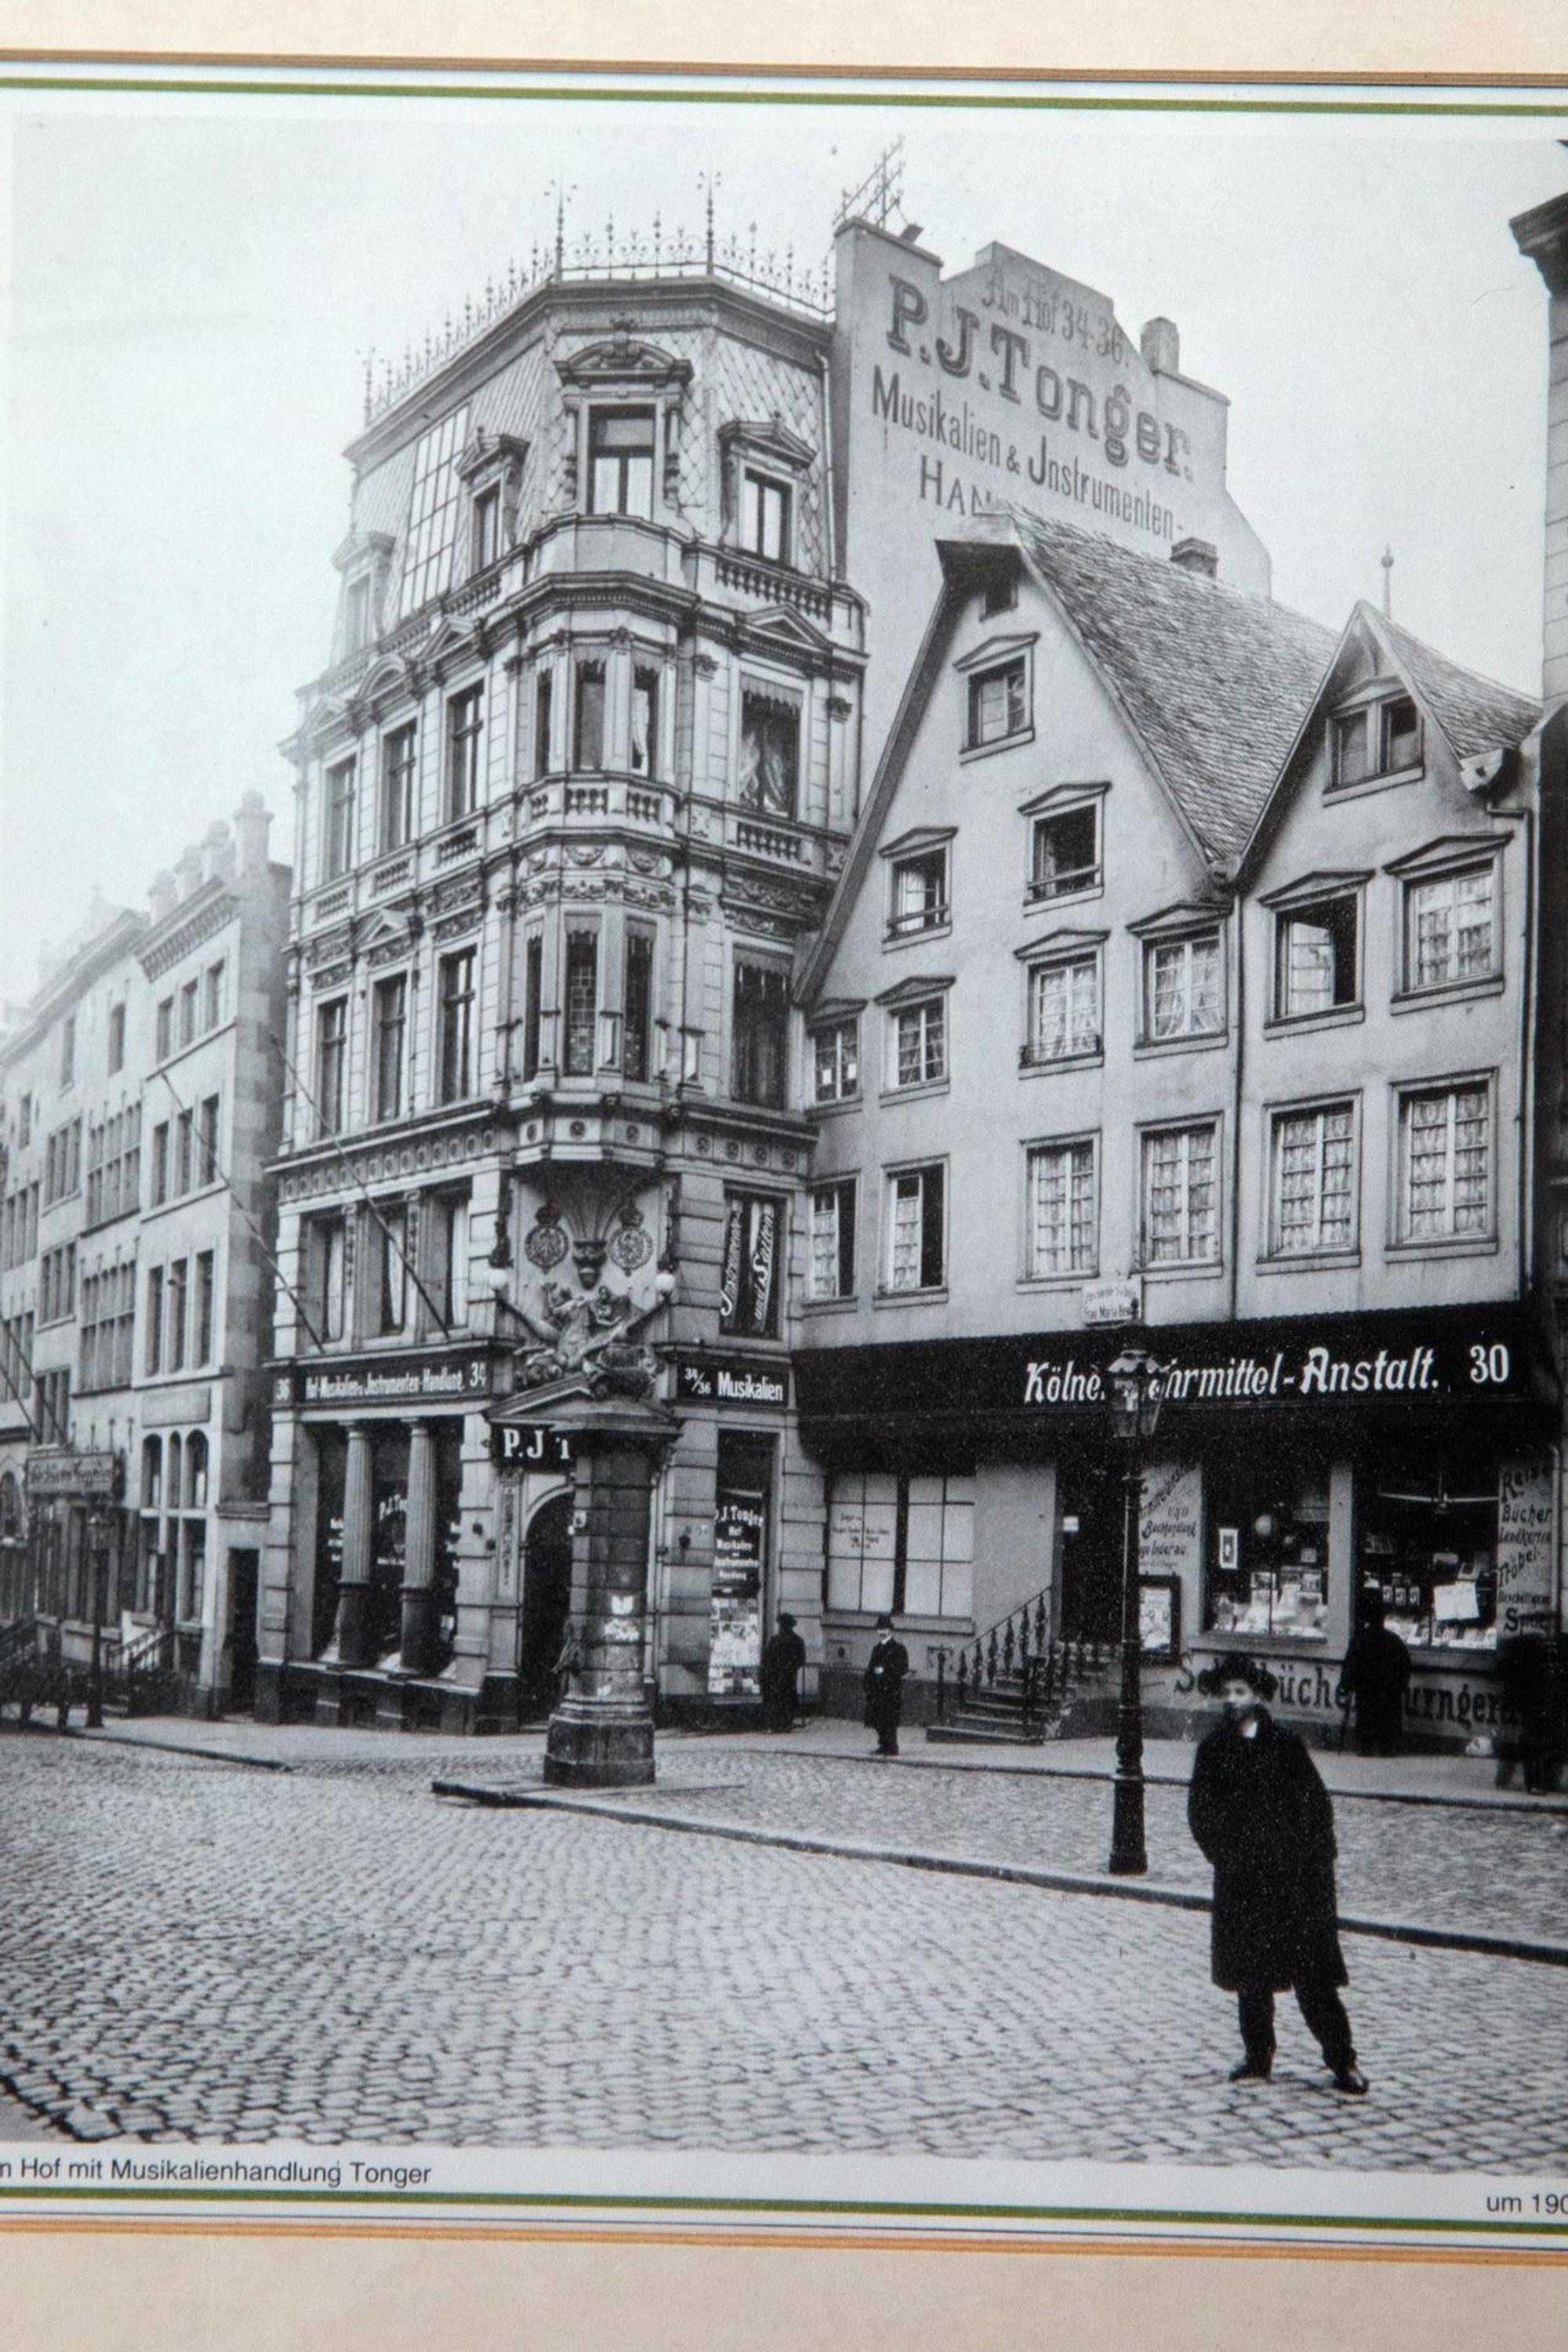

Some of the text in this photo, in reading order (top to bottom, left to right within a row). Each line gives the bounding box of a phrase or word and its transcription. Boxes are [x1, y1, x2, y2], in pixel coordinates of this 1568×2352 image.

[872, 364, 1001, 467] Musikalien
[1006, 441, 1020, 475] &
[470, 1361, 487, 1387] 34
[718, 1370, 783, 1401] Musikalien
[1024, 1359, 1105, 1403] Kölne
[1470, 1345, 1508, 1383] 30
[275, 1377, 291, 1401] 36
[1502, 1504, 1552, 1526] Bücher
[21, 2157, 61, 2179] Hof
[69, 2158, 103, 2180] mit
[111, 2158, 342, 2187] Musikalienhandlung
[350, 2161, 431, 2189] Tonger
[1486, 2195, 1522, 2213] um
